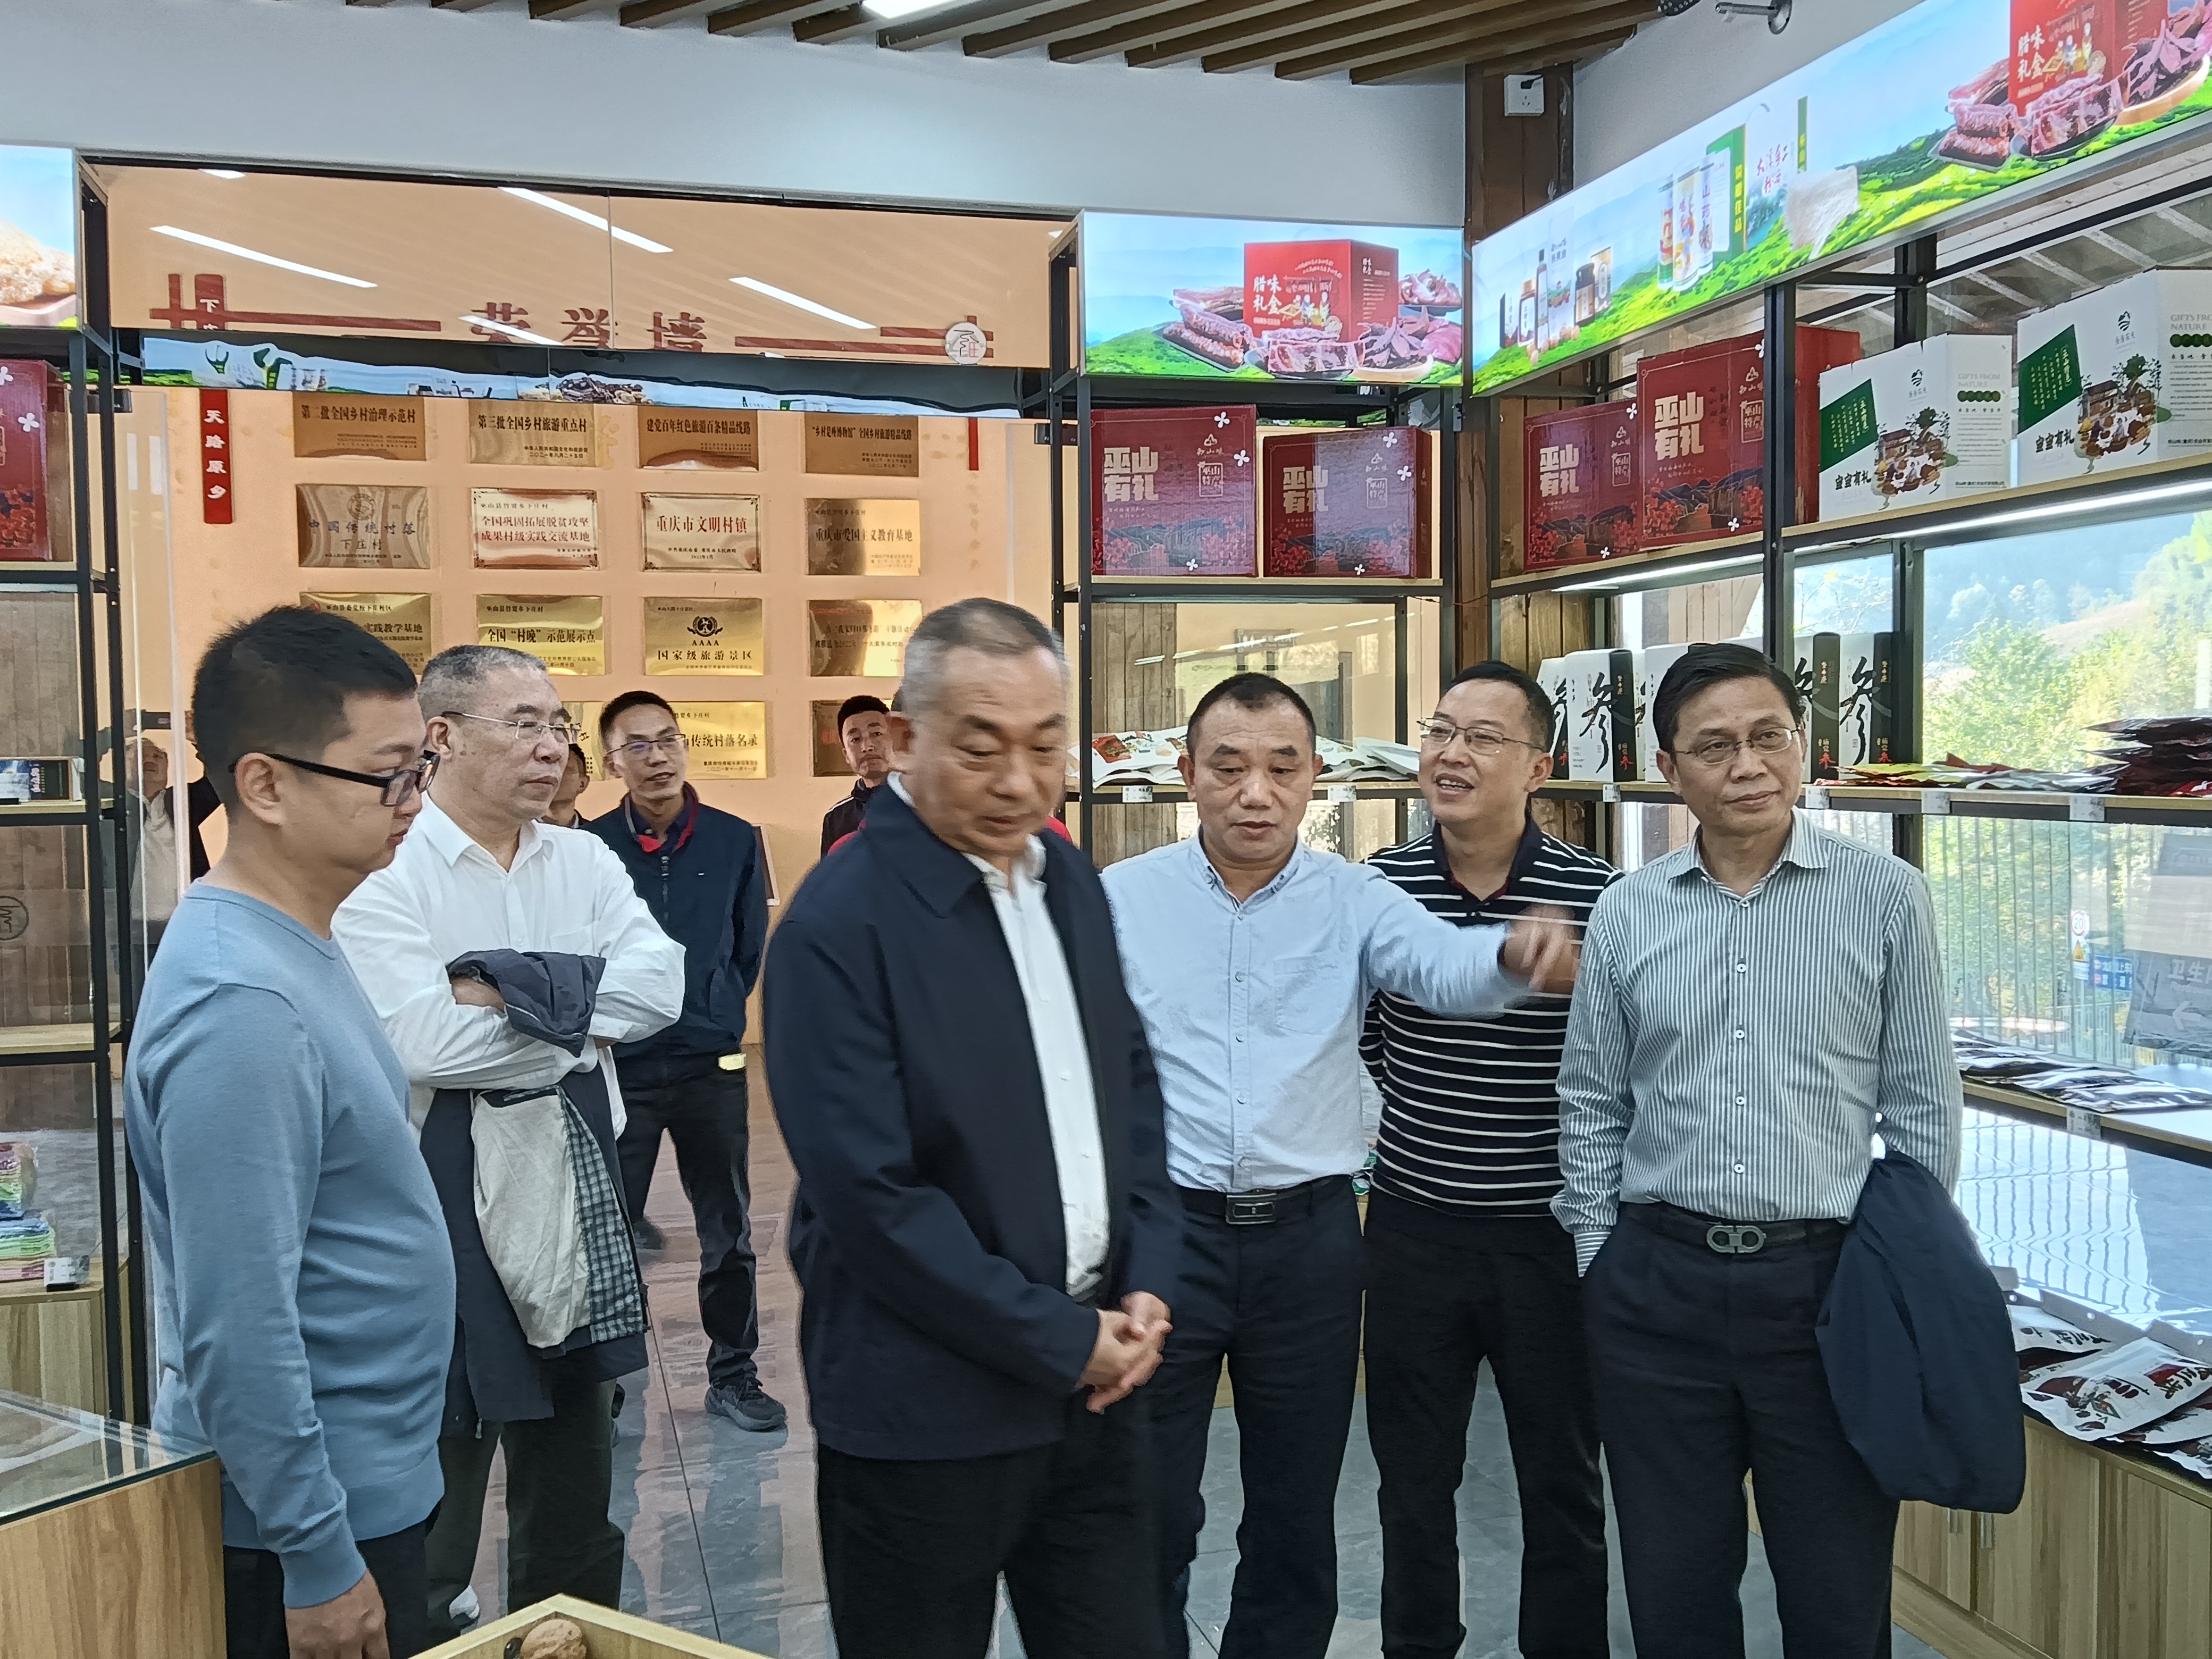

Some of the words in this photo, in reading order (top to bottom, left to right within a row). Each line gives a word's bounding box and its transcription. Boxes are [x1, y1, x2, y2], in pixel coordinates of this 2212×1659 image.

[1253, 274, 1282, 293] 腊味
[1253, 294, 1283, 315] 礼盒
[301, 405, 416, 423] 第二批全国乡村治理示范村
[1655, 391, 1704, 430] 巫山
[478, 415, 586, 432] 第三批全国乡村旅游重点村
[647, 418, 750, 435] 建党百年红色旅游百条精品线路
[1655, 423, 1705, 461] 有礼
[1104, 446, 1159, 474] 巫山
[1540, 443, 1579, 473] 巫山
[1283, 465, 1328, 490] 巫山
[1540, 468, 1580, 498] 有礼
[1104, 474, 1159, 502] 有礼
[1283, 489, 1329, 514] 有礼
[309, 521, 415, 534] 中国传统村落
[481, 516, 590, 527] 全国巩固拓展脱贫攻坚
[657, 515, 747, 533] 重庆市文明村镇
[481, 531, 590, 542] 成果村级实践交流基地
[816, 528, 913, 542] 重庆市爱国主义教育基地
[341, 539, 382, 550] 下庄村
[658, 650, 752, 661] 国家级旅游景区
[2074, 918, 2084, 929] 20
[2167, 959, 2212, 985] 卫生
